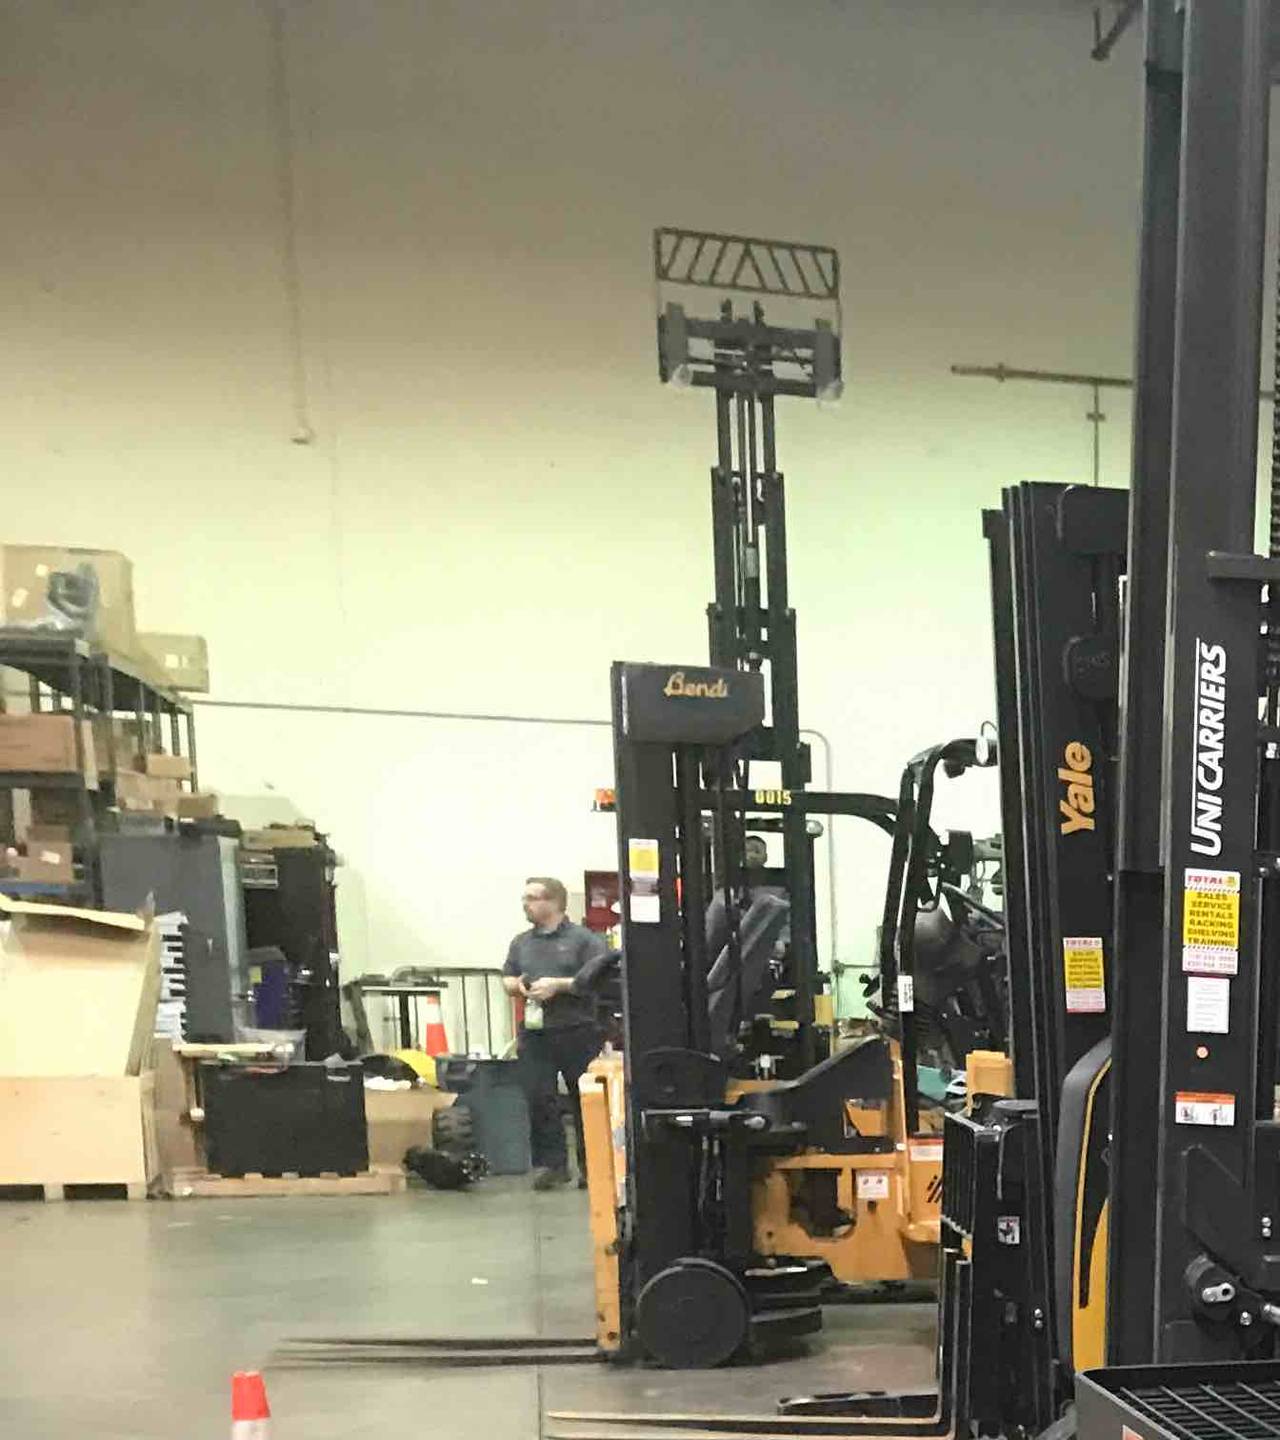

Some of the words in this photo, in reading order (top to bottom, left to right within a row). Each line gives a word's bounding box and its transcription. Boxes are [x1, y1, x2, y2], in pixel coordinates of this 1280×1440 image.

[1190, 640, 1227, 857] UNICARRIERS
[1057, 741, 1095, 836] Yale
[1191, 900, 1232, 910] SERVICE
[1189, 909, 1233, 919] RENTALS
[1189, 918, 1233, 928] RACKING
